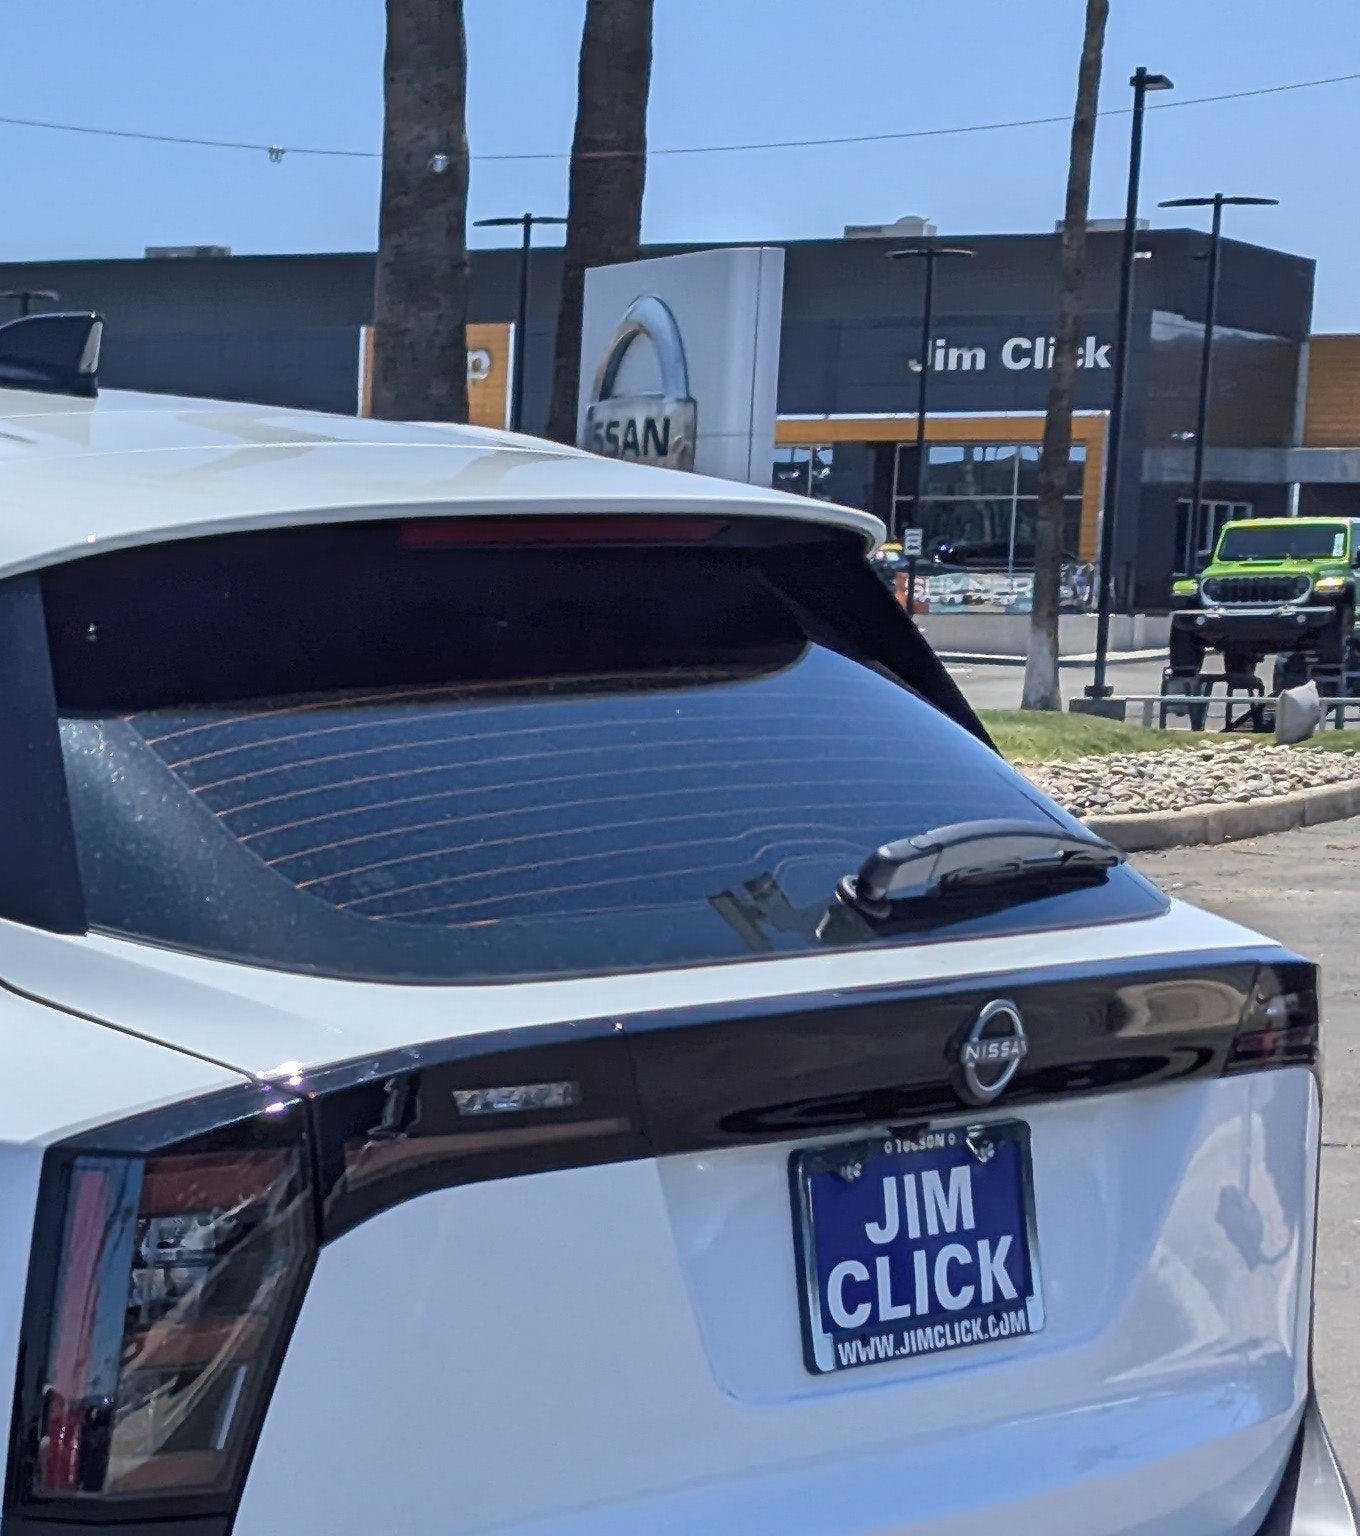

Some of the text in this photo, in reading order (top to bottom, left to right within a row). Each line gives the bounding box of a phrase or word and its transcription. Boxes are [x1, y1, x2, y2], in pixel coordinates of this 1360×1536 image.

[1001, 335, 1112, 370] Clik
[965, 1039, 1027, 1062] NISSAN
[864, 1165, 976, 1245] JIM
[827, 1235, 1019, 1330] CLICK
[838, 1309, 1027, 1366] WWW.JIMCLICK.COM
